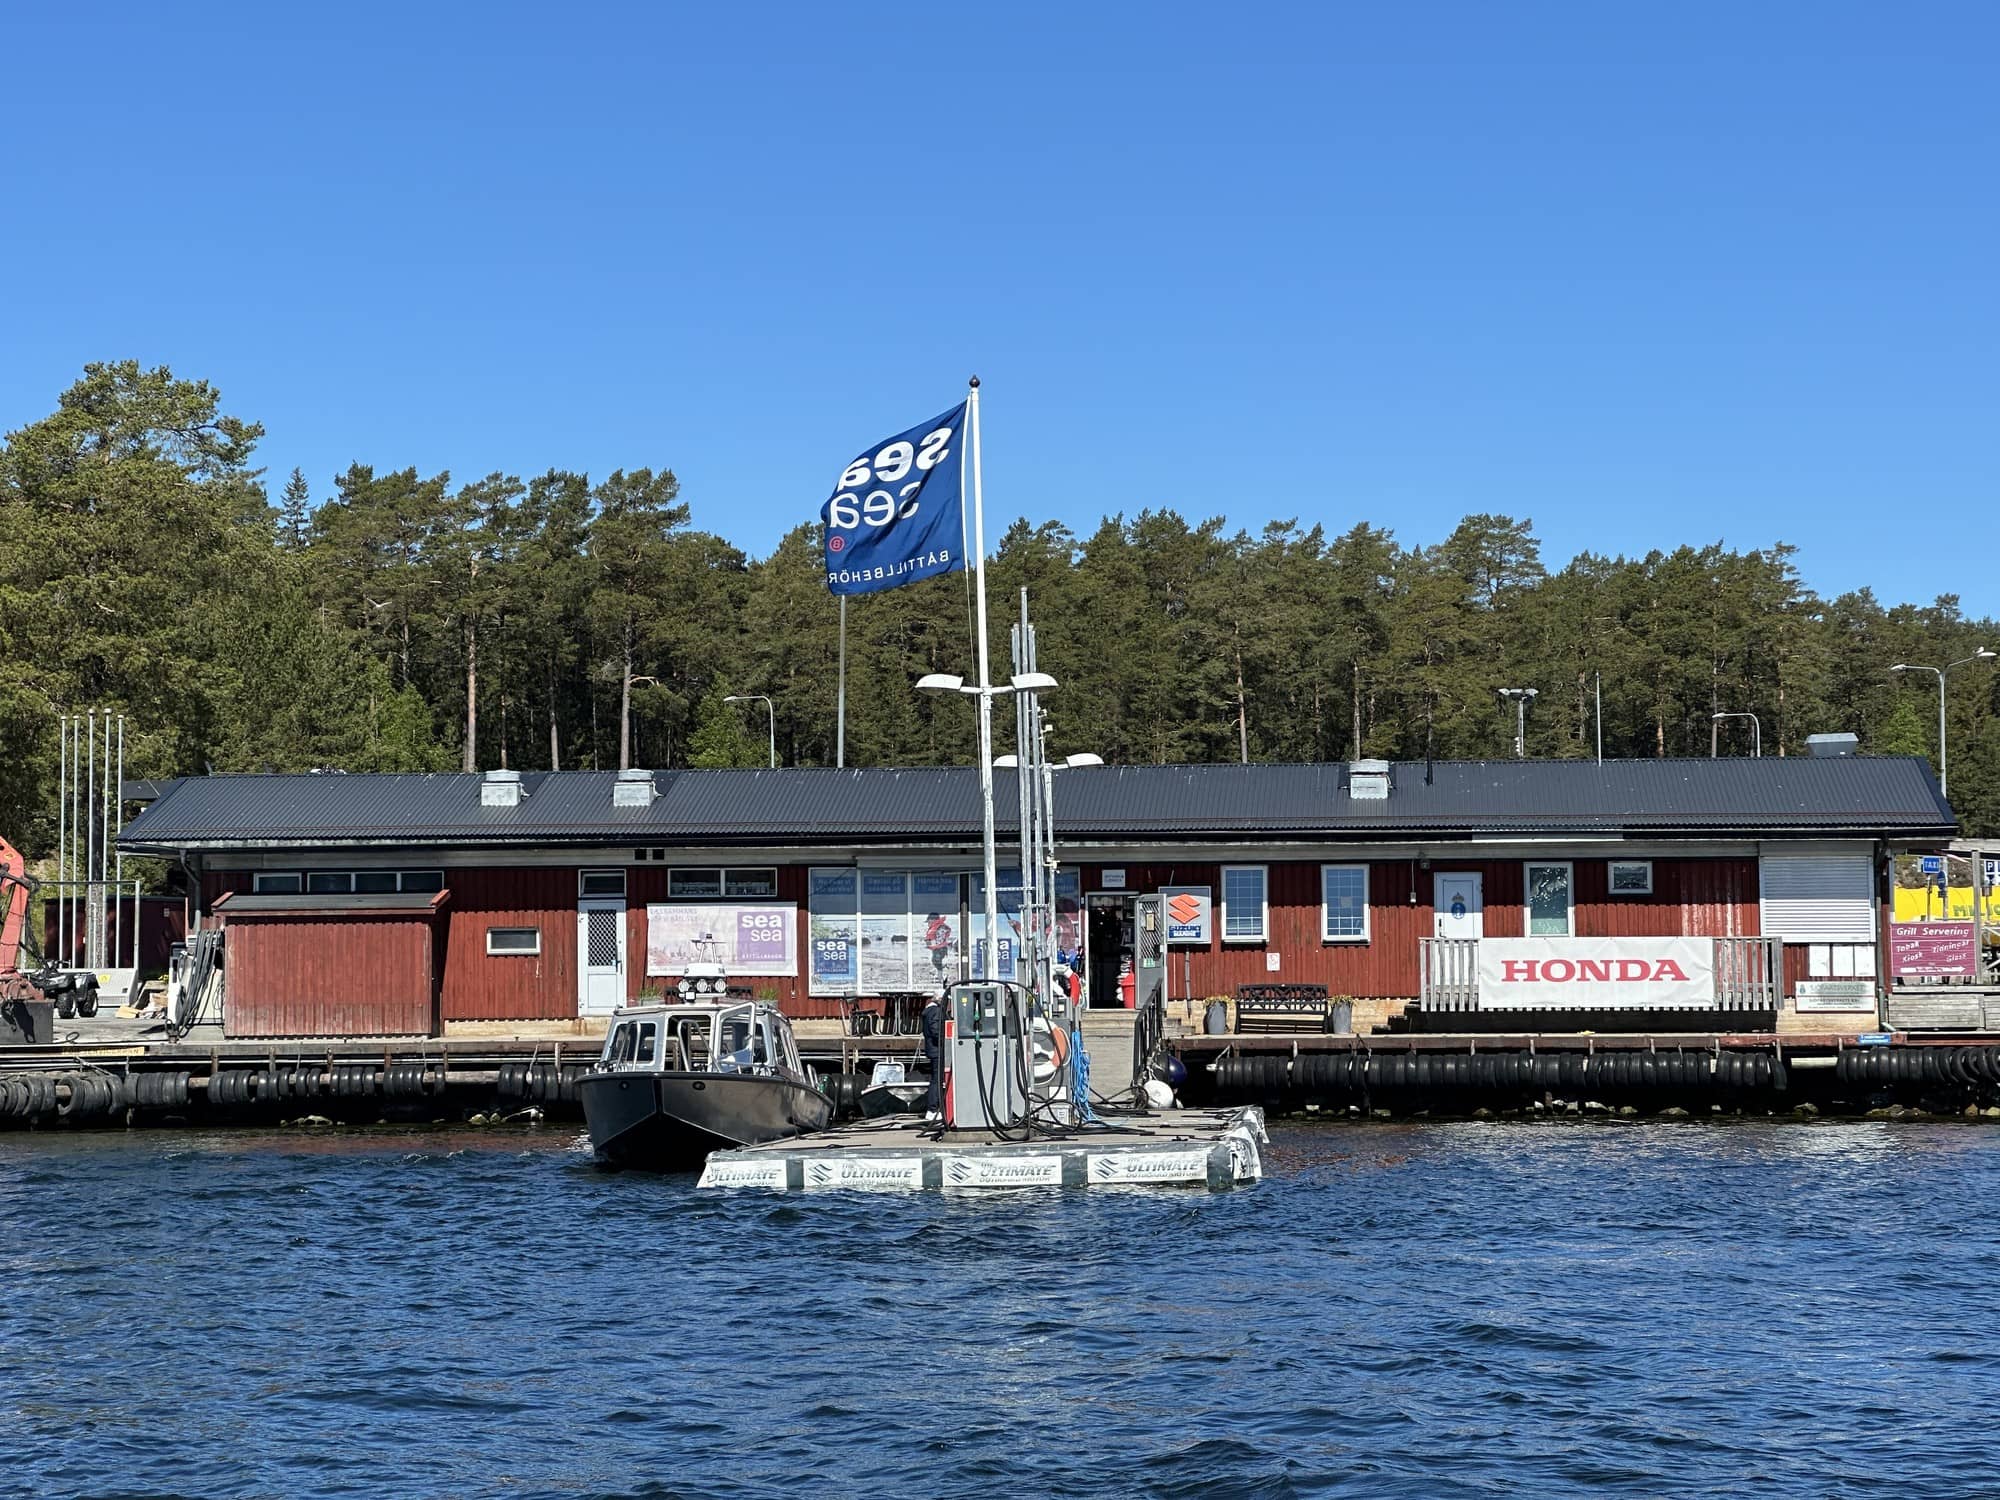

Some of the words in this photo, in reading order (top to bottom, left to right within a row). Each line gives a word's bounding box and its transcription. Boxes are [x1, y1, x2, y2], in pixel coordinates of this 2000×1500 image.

[1925, 861, 1939, 869] TAXI
[741, 914, 782, 928] sea
[751, 929, 782, 942] sea
[1896, 927, 1917, 936] Grill
[1922, 926, 1969, 937] Servering
[817, 941, 847, 951] sea
[823, 951, 847, 960] sea
[1501, 959, 1690, 982] HONDA
[980, 1165, 1056, 1177] ULTIMATE
[1128, 1159, 1202, 1172] ULTIMATE
[841, 1167, 916, 1178] ULTIMATE
